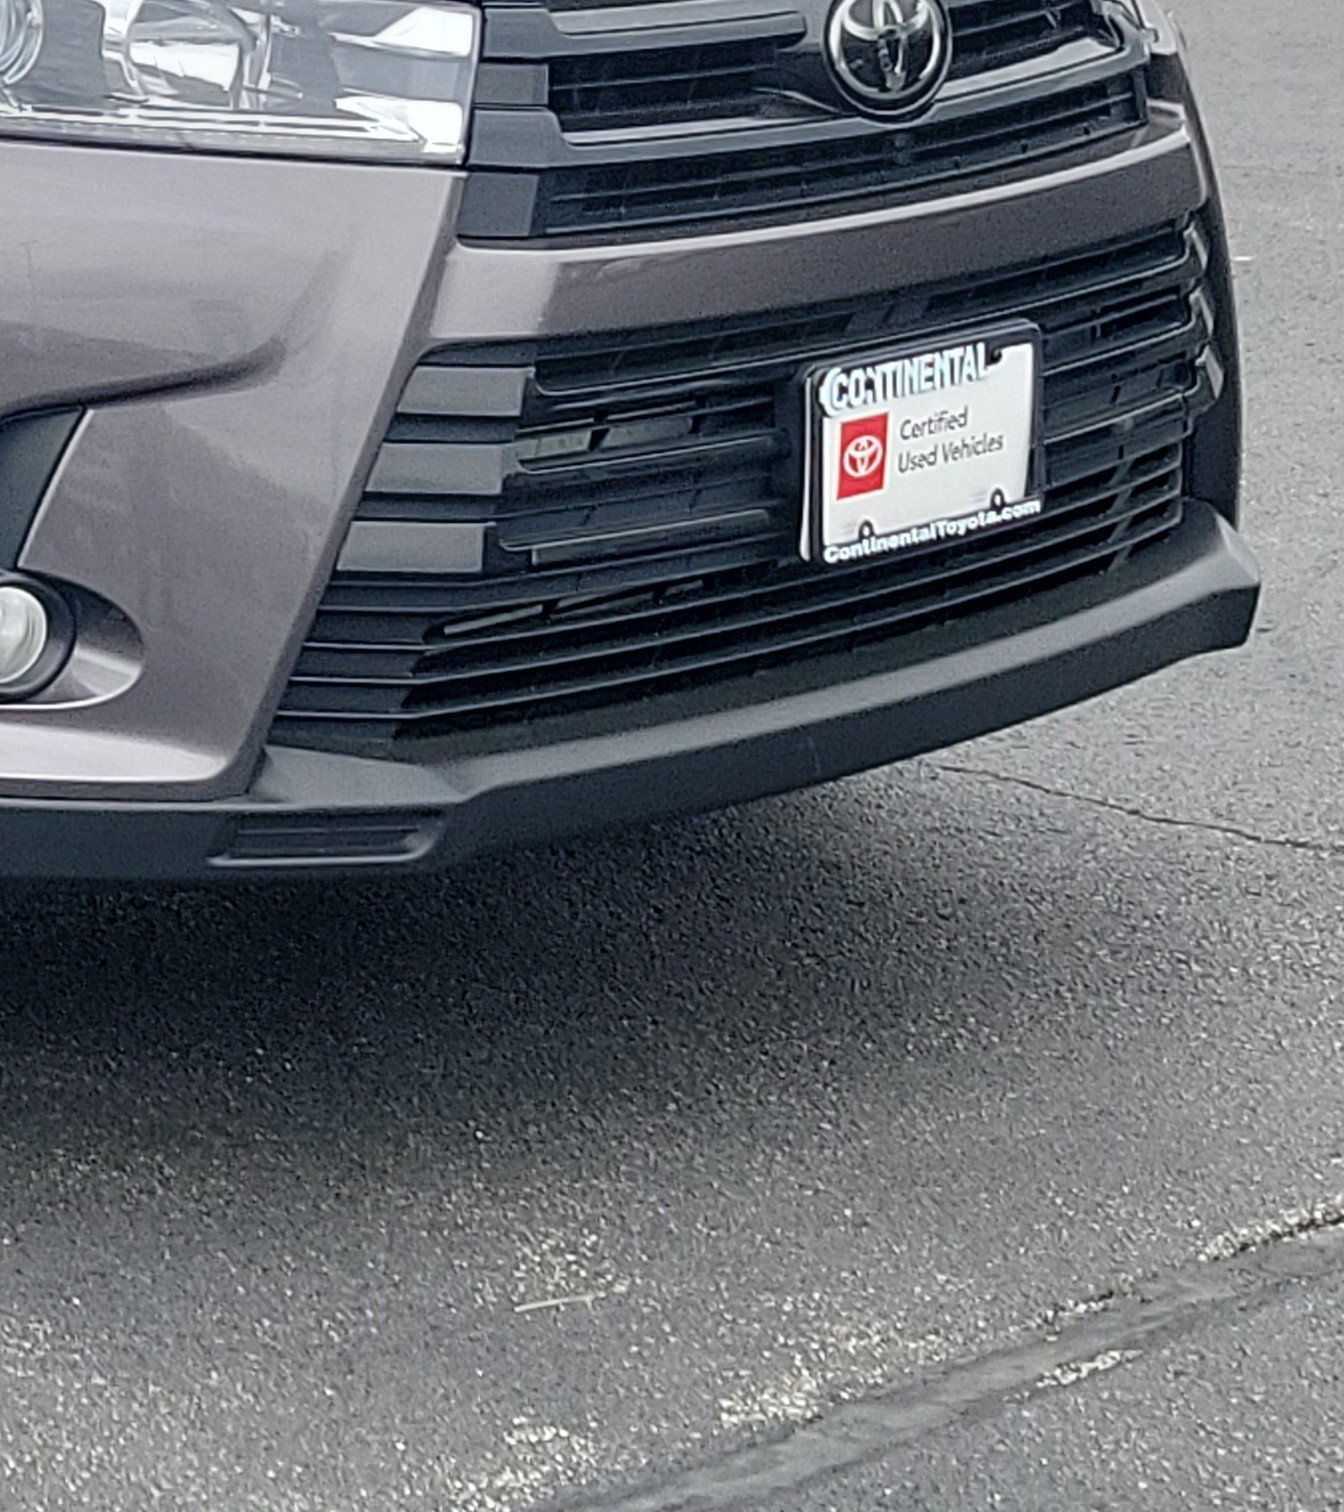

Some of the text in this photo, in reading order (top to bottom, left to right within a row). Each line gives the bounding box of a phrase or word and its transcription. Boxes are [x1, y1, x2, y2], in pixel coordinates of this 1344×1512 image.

[831, 341, 988, 409] CONTINENTAL
[899, 404, 969, 441] Certified
[897, 432, 1005, 474] Used Vehicles
[823, 498, 1042, 564] ContinentalToyota.com
